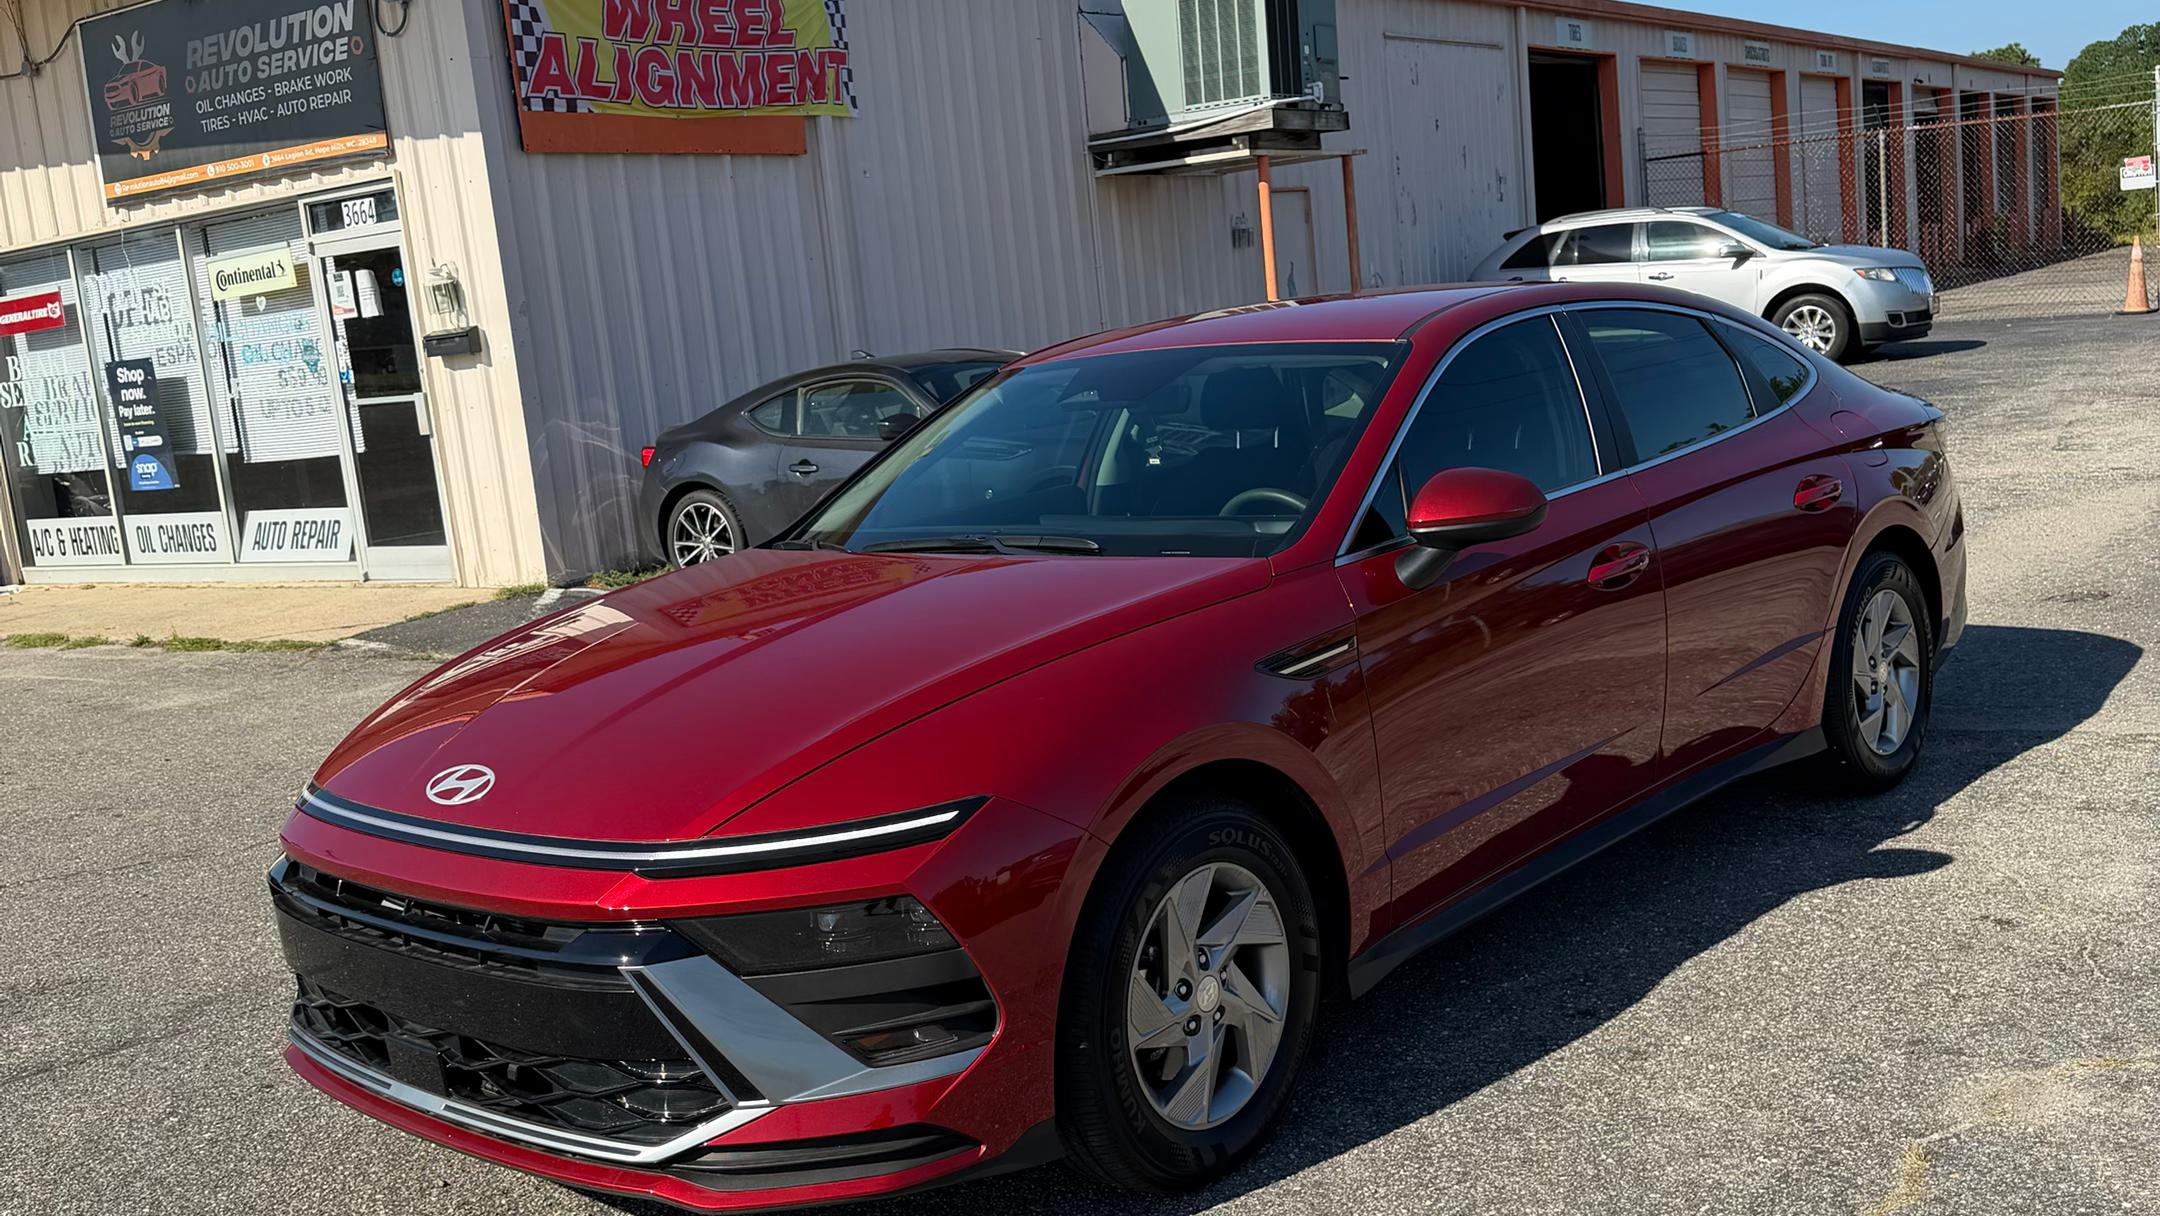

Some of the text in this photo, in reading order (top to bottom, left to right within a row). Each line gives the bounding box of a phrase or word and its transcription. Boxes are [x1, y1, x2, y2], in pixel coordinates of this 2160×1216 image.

[186, 0, 354, 69] REVOLUTION
[602, 0, 798, 48] WHEEL
[198, 37, 348, 92] AUTO SERVICE
[527, 31, 850, 109] ALIGNMENT
[195, 99, 214, 114] OIL
[215, 87, 266, 110] CHANGES
[274, 76, 312, 96] BRAKE
[314, 67, 353, 87] WORK
[110, 103, 170, 128] REVOLUTION
[136, 117, 168, 132] SERVICE
[200, 115, 230, 133] TIRES
[238, 107, 268, 125] HVAC
[276, 98, 307, 117] AUTO
[309, 89, 352, 110] REPAIR
[343, 200, 375, 227] 3664
[215, 261, 276, 292] Continental
[116, 367, 144, 385] Shop
[121, 387, 147, 401] now.
[118, 404, 156, 420] Pay later.
[32, 524, 120, 557] A/C & HEATING
[135, 522, 217, 553] OIL CHANGES
[252, 519, 341, 551] AUTO REPAIR
[1208, 827, 1273, 857] SOLUS
